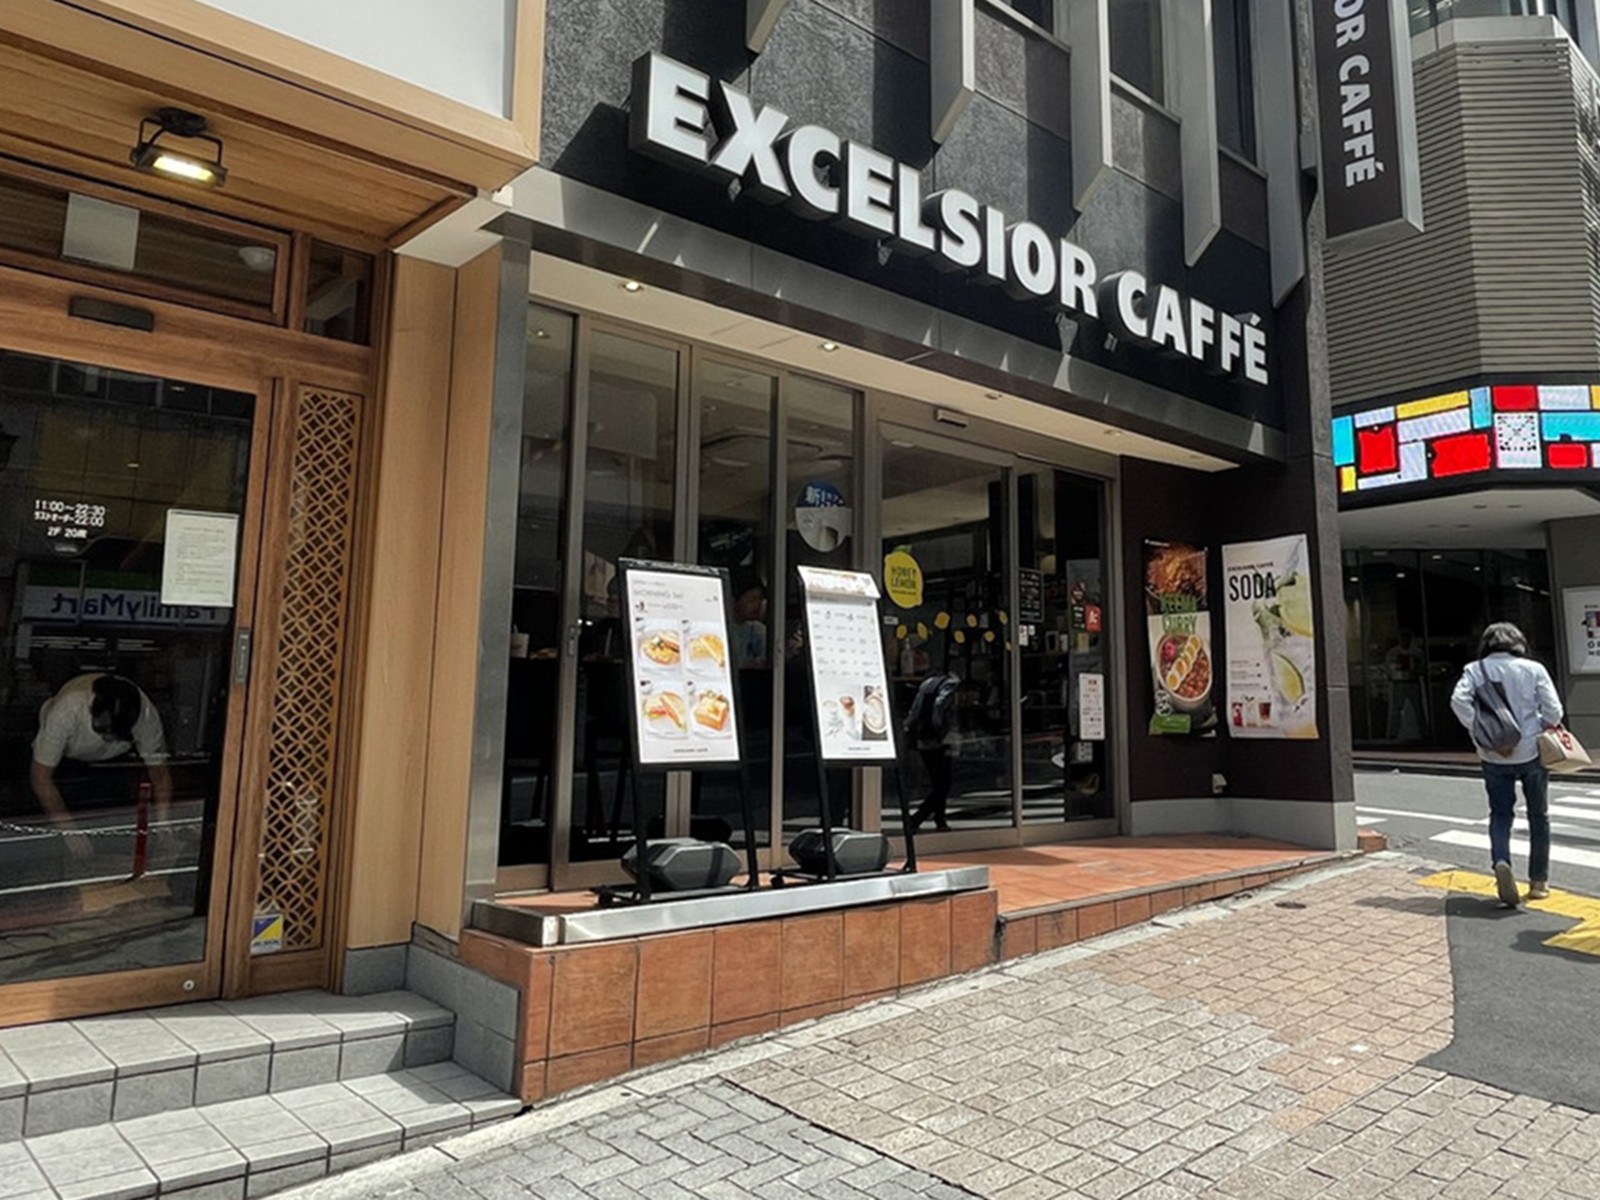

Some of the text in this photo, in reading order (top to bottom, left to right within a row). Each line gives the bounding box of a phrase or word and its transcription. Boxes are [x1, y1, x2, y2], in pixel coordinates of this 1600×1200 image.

[1339, 55, 1384, 187] CAFFÉ
[647, 53, 1269, 385] EXCELSIOR CAFFÉ
[1229, 572, 1277, 601] SODA
